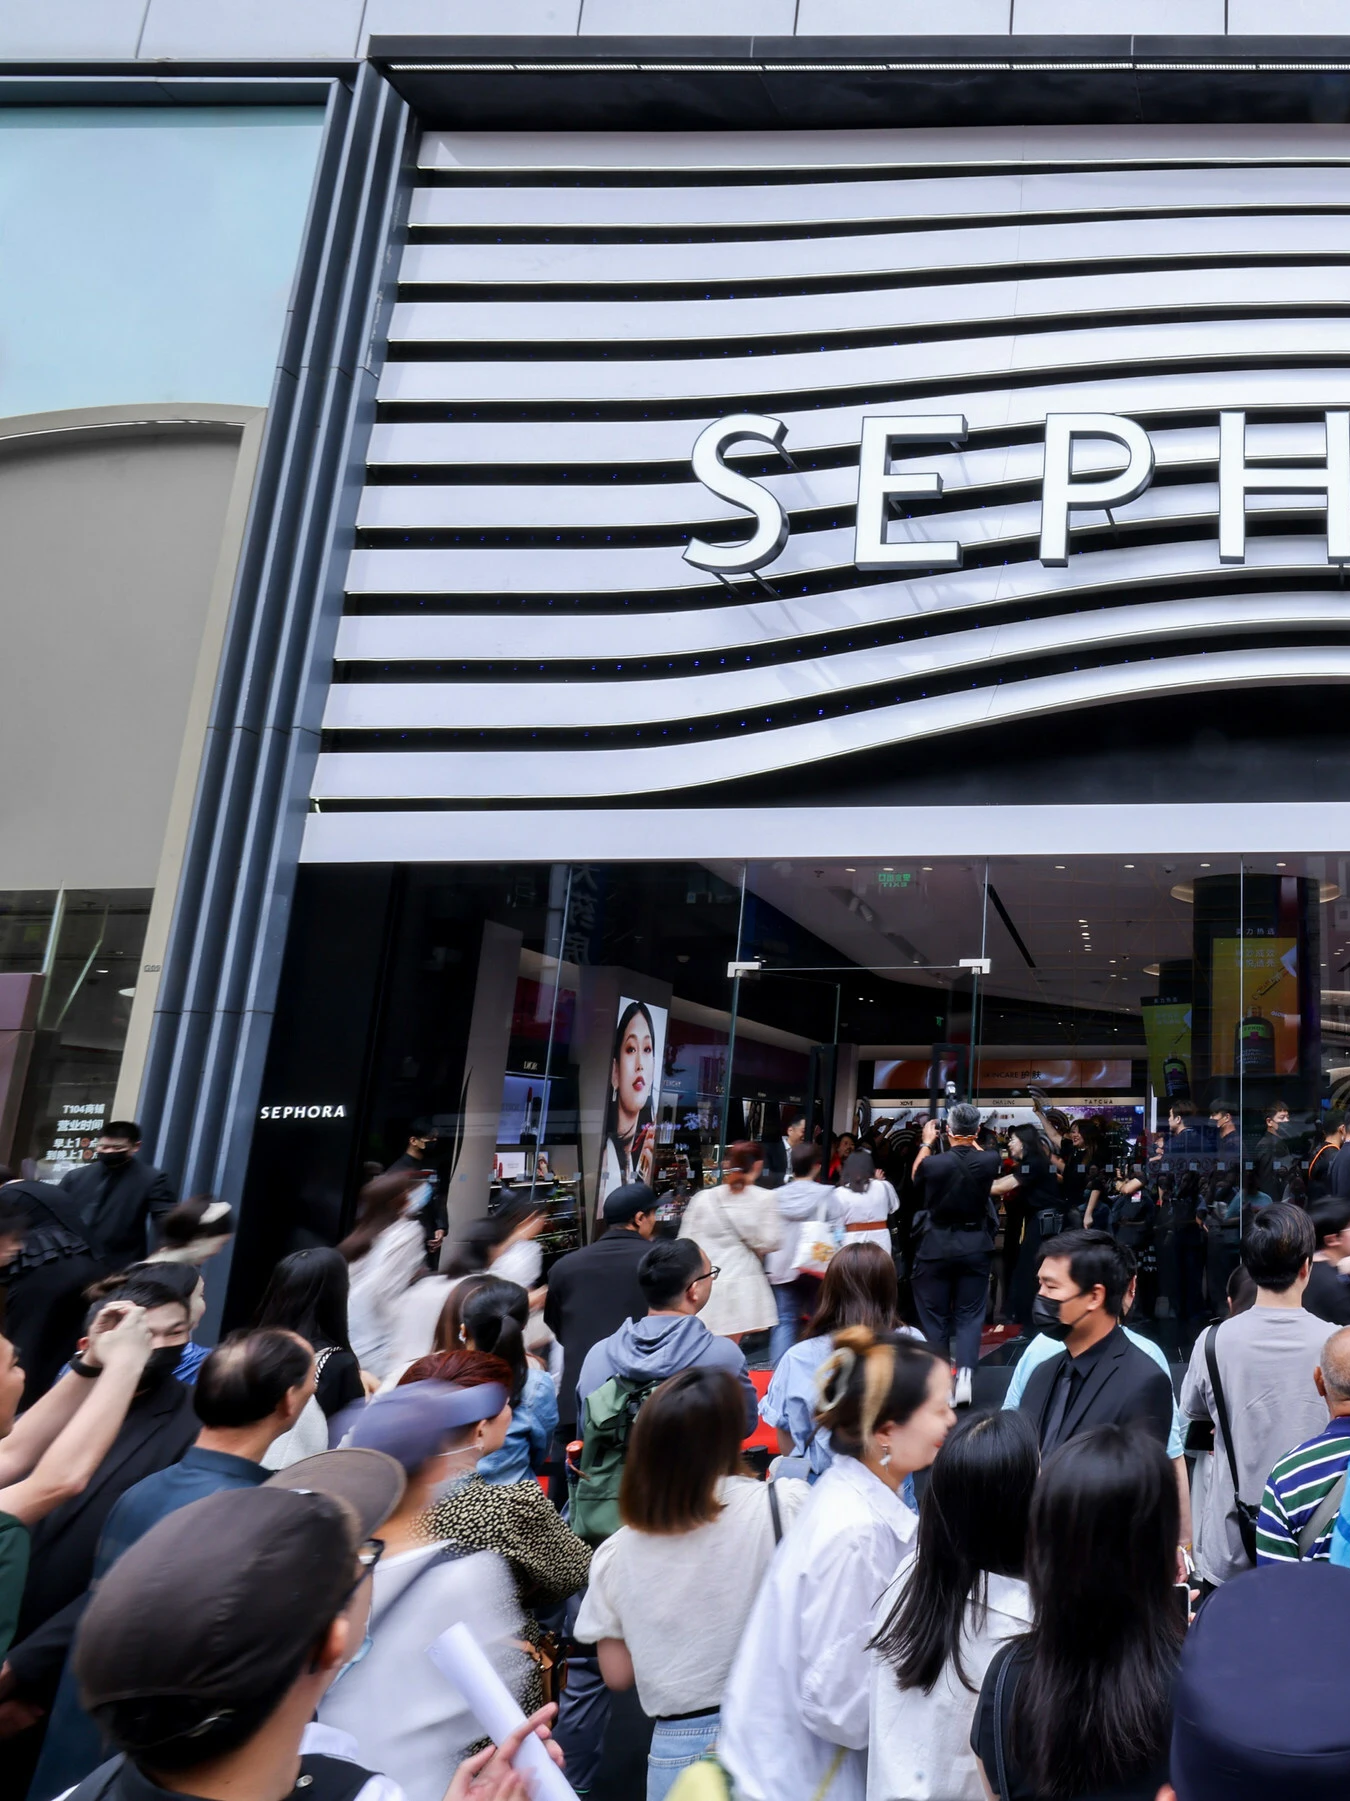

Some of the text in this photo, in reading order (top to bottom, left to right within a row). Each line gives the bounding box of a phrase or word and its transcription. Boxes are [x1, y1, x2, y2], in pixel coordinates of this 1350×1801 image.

[260, 1105, 346, 1119] SEPHORA
[52, 1137, 99, 1149] 早上1点
